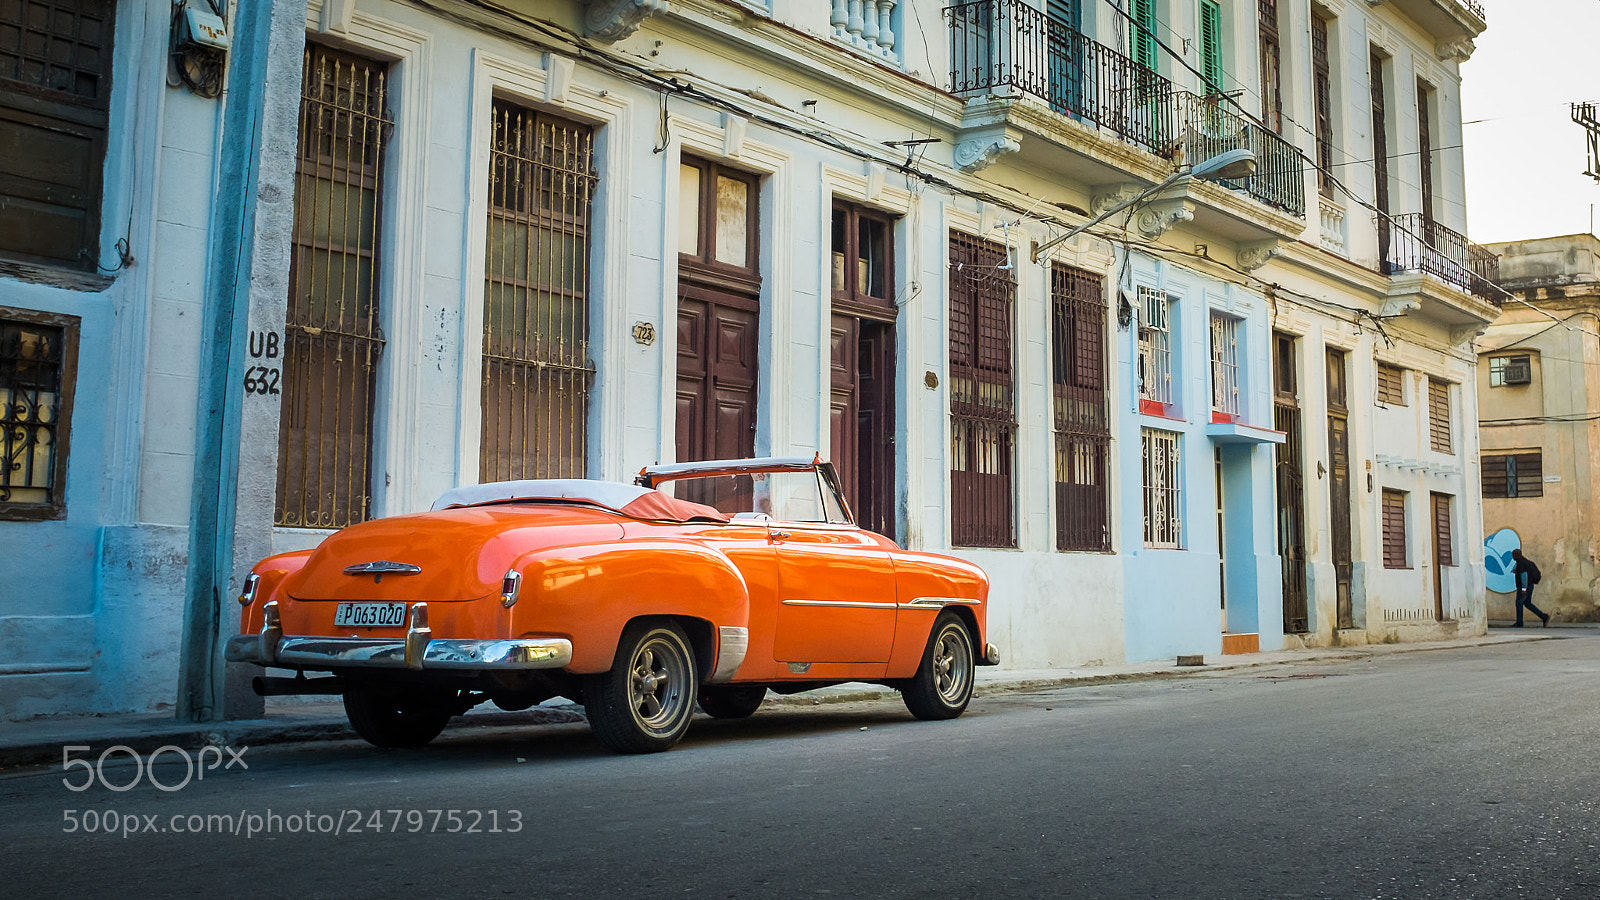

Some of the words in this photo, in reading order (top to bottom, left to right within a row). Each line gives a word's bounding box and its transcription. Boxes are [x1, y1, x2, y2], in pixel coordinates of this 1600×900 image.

[250, 330, 280, 358] UB
[637, 325, 652, 341] 723
[244, 366, 280, 395] 632
